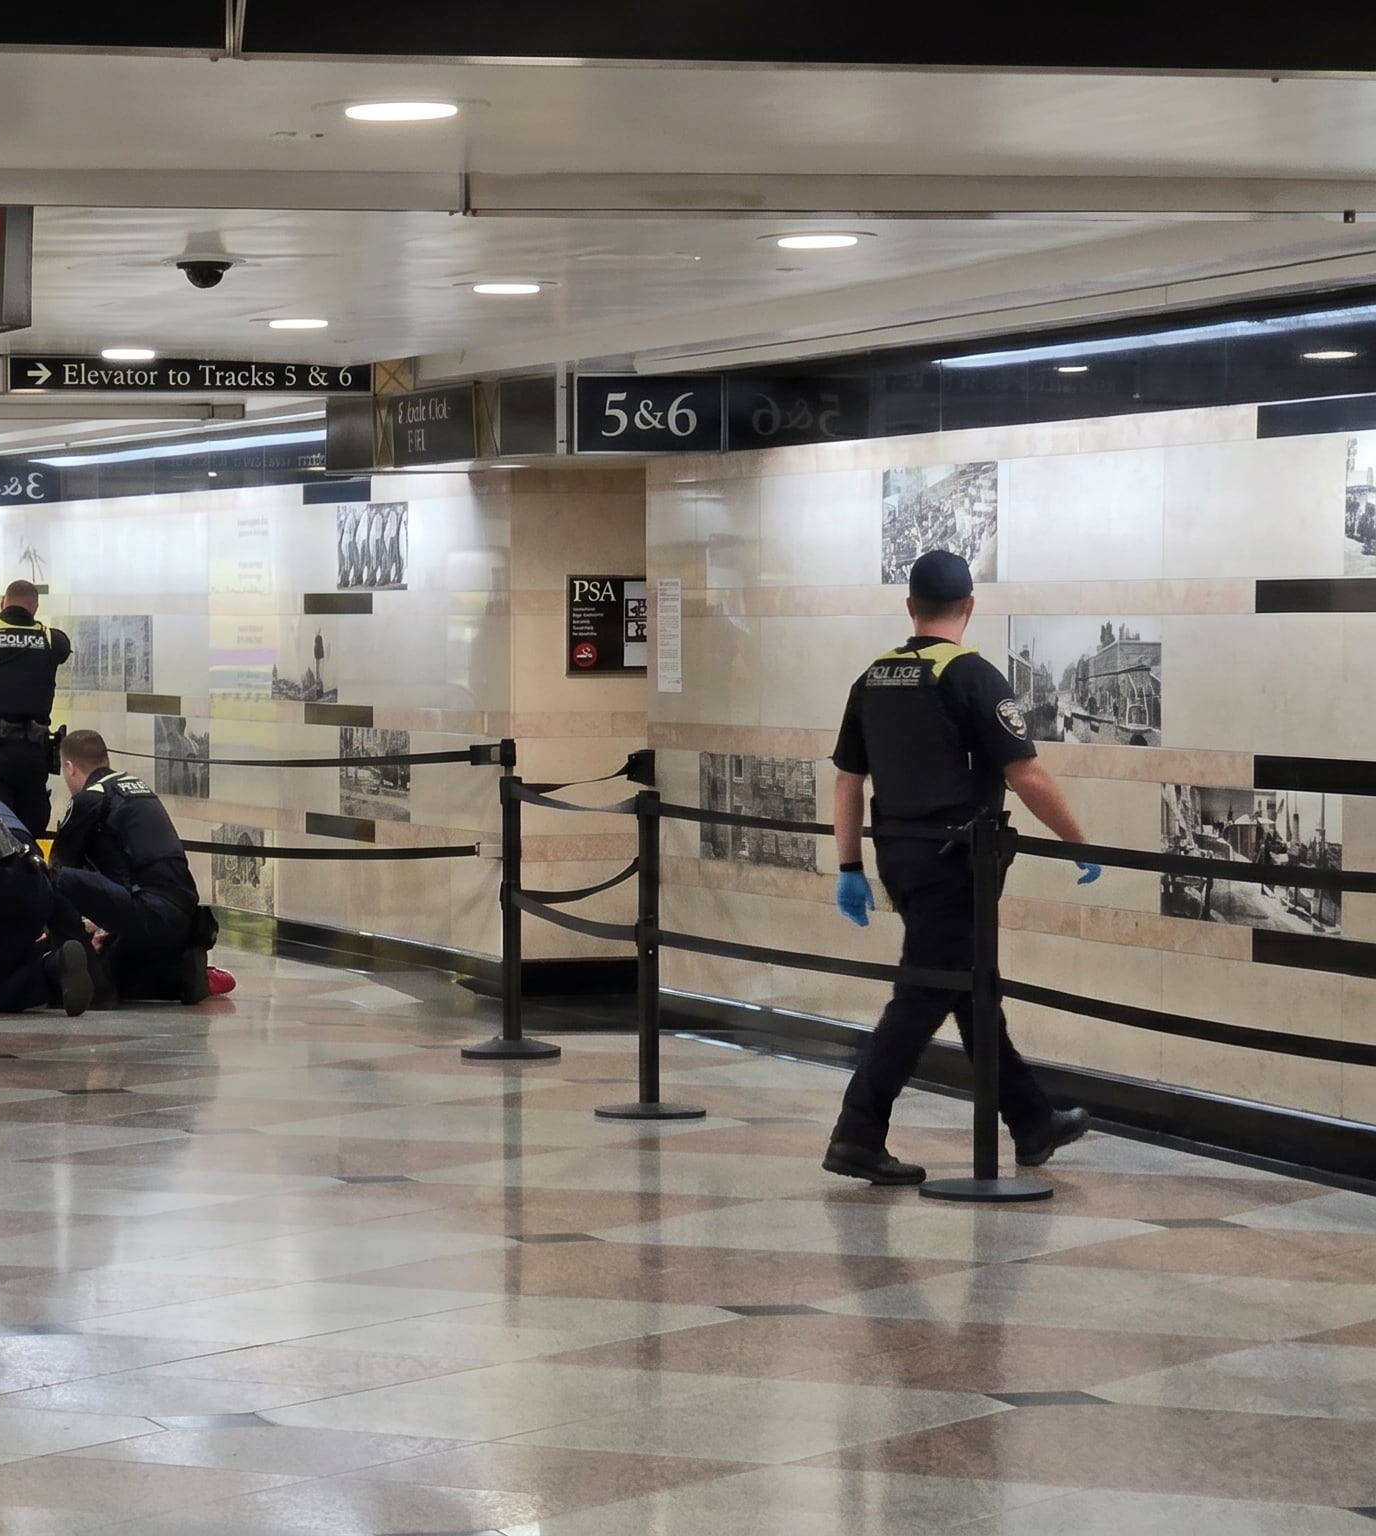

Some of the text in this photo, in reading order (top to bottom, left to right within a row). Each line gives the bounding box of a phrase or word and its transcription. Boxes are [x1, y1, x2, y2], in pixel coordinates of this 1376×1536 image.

[62, 364, 158, 386] Elevator
[168, 369, 191, 386] to
[199, 364, 275, 386] Tracks
[308, 365, 330, 387] &
[338, 365, 353, 387] 6
[601, 391, 697, 437] 5&6
[573, 580, 616, 602] PSA
